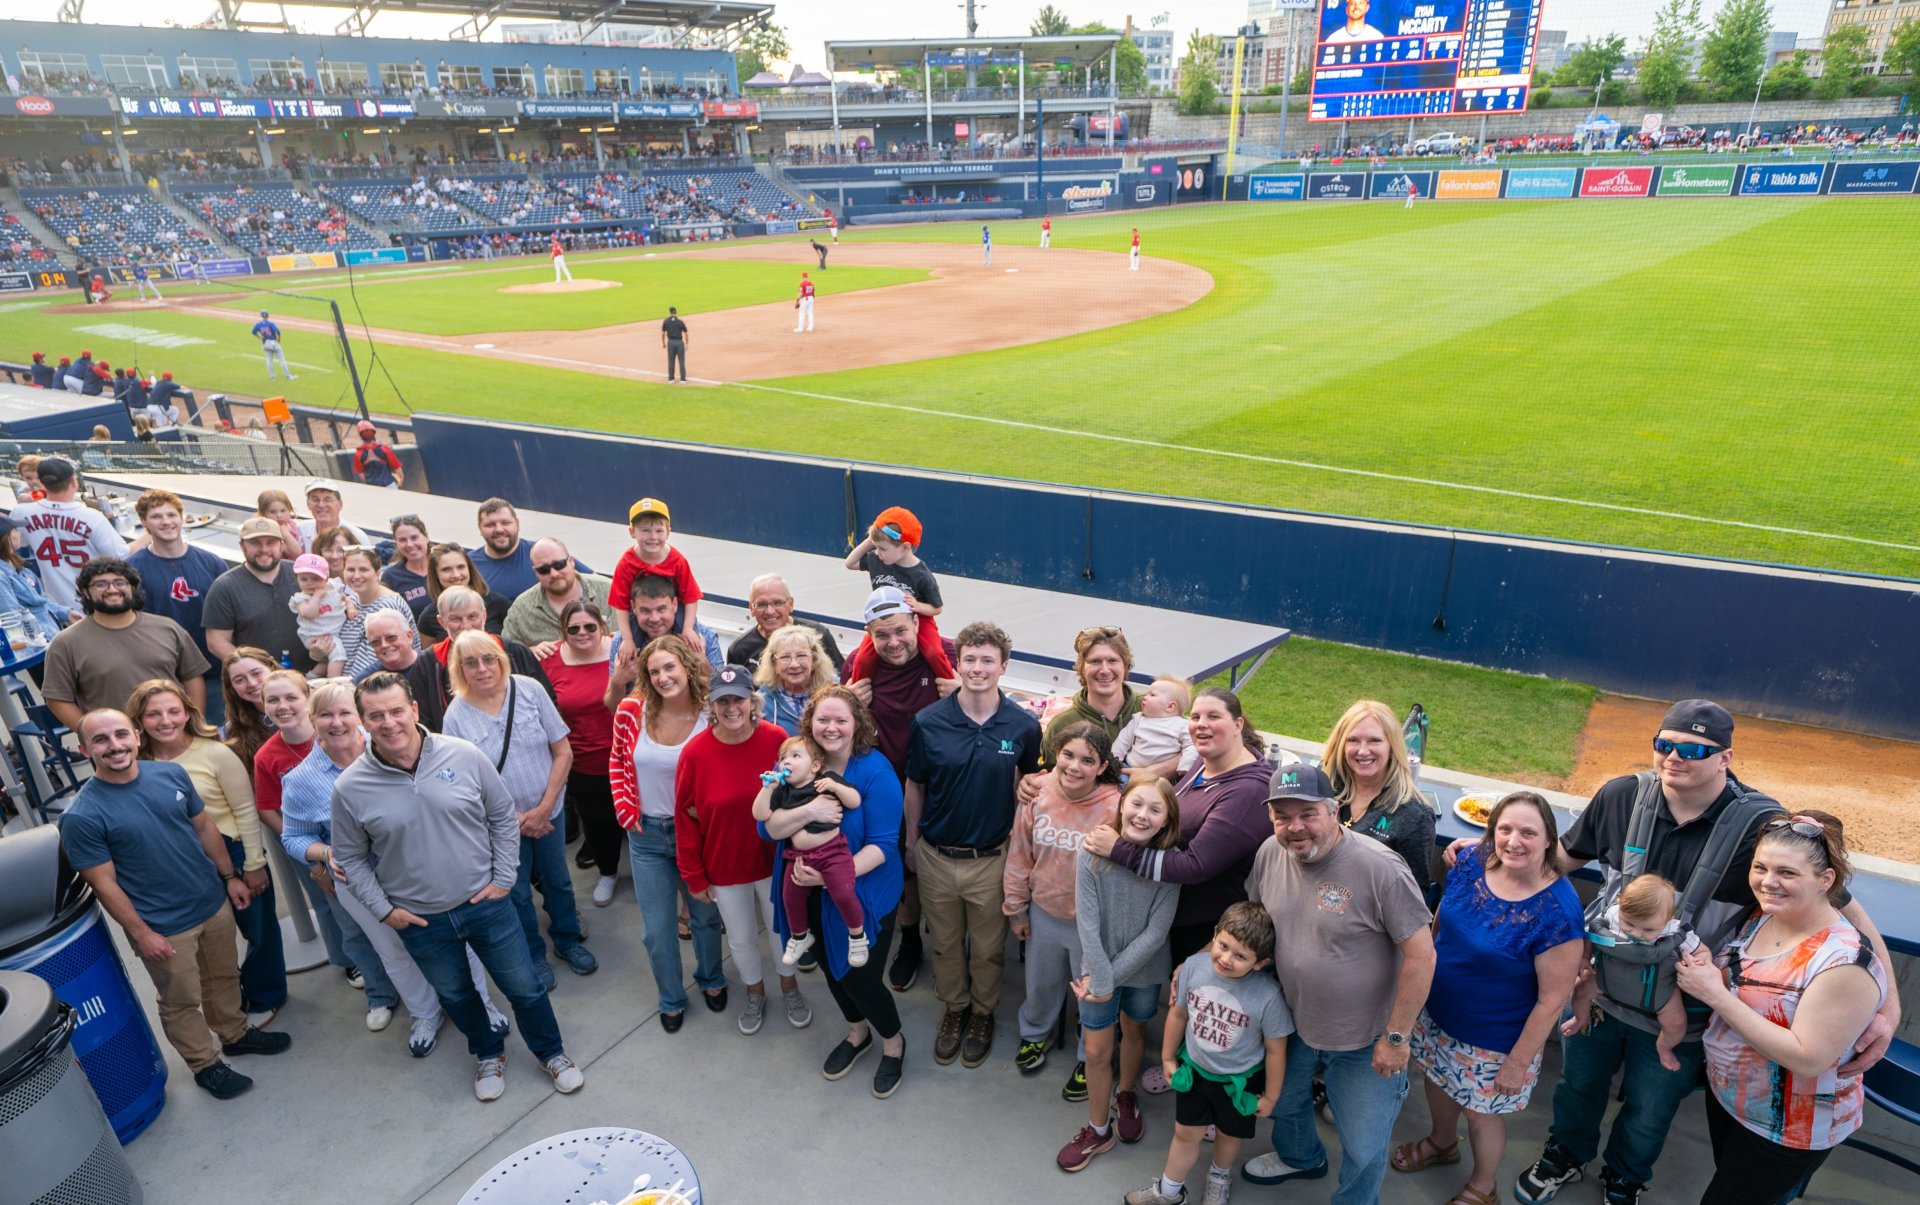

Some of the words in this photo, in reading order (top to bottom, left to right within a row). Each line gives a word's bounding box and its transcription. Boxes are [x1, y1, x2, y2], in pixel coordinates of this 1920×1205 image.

[1414, 5, 1435, 18] RYAN
[1398, 16, 1448, 35] MCCARTY
[20, 100, 51, 111] Hood
[122, 99, 139, 114] BUF
[149, 101, 158, 113] 0
[161, 101, 181, 114] WOR
[189, 102, 196, 114] 1
[221, 104, 256, 116] MCCARTY
[537, 105, 576, 113] WORCESTER
[576, 105, 601, 113] RAILERS
[602, 104, 612, 113] HC
[1465, 98, 1471, 111] 1
[1486, 97, 1494, 110] 2
[1507, 96, 1515, 109] 2
[277, 105, 284, 117] 1
[290, 105, 297, 117] 2
[301, 105, 308, 117] 2
[900, 167, 932, 175] VISITORS
[1264, 180, 1300, 189] Assumption
[1440, 180, 1497, 191] fallonhealth
[1663, 178, 1729, 188] bankHometown
[1770, 173, 1796, 186] Table
[1799, 172, 1818, 185] Talk
[1264, 187, 1296, 196] University
[1320, 184, 1352, 194] OSTROW
[1587, 185, 1642, 193] SAINT-GOBAIN
[24, 513, 93, 540] MARTINEZ
[36, 535, 90, 569] 45
[1281, 771, 1297, 785] M
[1033, 813, 1087, 851] Rees
[1317, 880, 1353, 899] STURGIS
[1186, 990, 1250, 1028] PLAYER
[1196, 1012, 1209, 1024] OF
[1211, 1018, 1230, 1033] THE
[1193, 1021, 1228, 1048] YEAR
